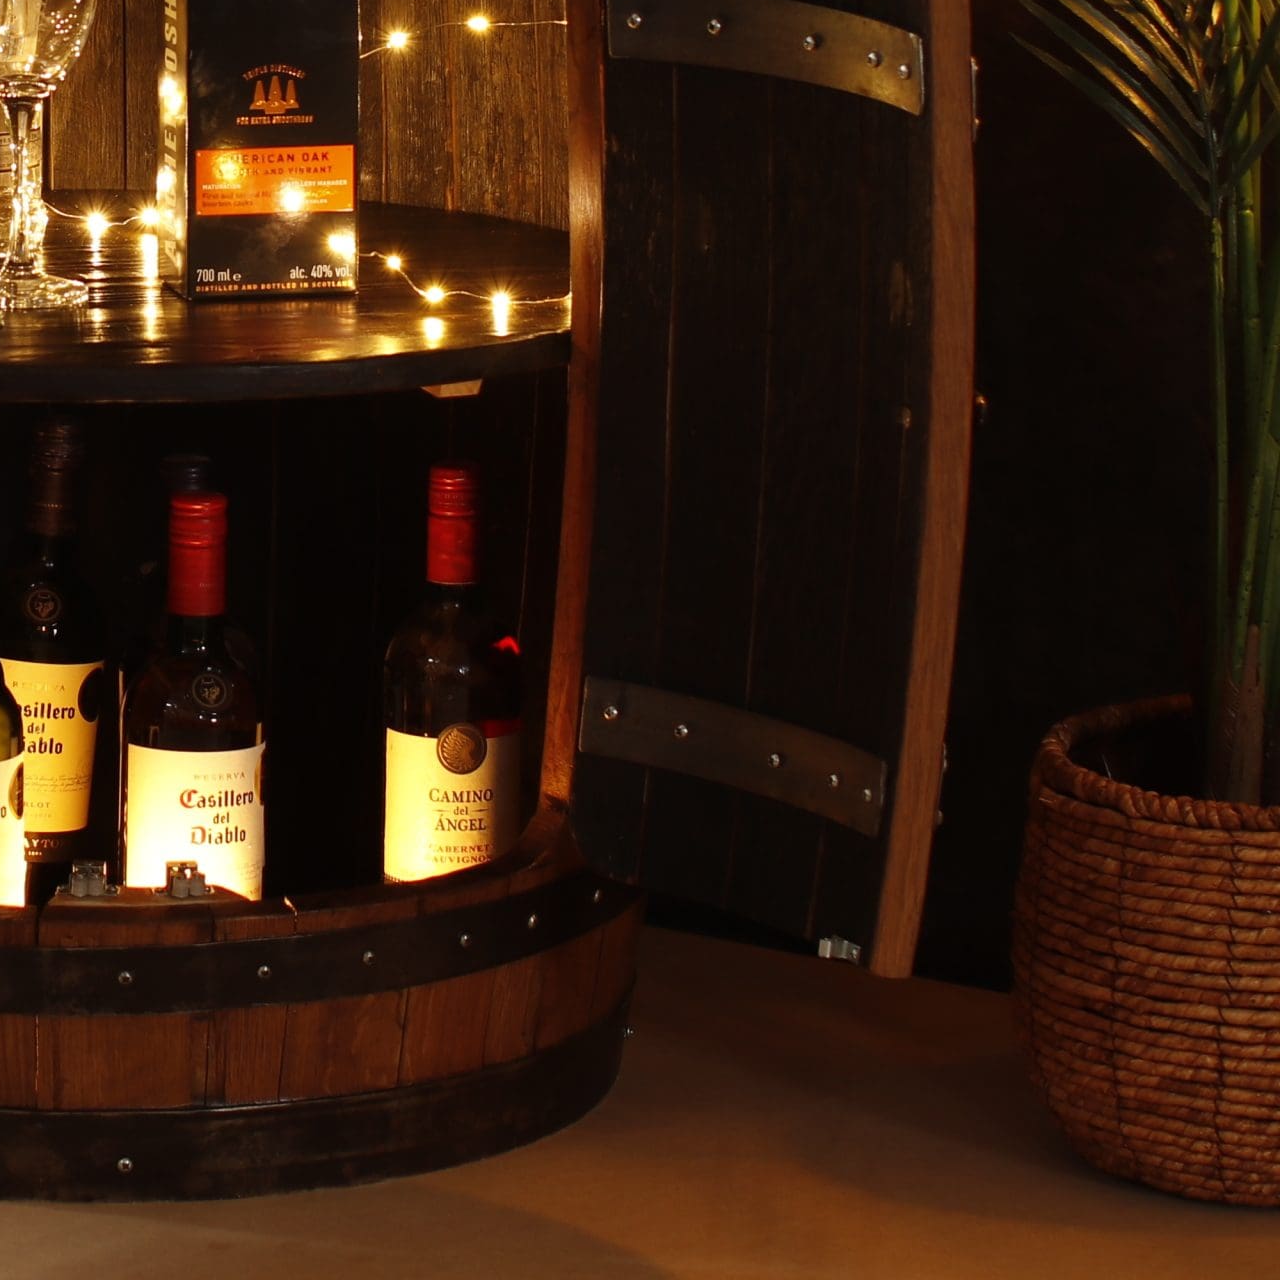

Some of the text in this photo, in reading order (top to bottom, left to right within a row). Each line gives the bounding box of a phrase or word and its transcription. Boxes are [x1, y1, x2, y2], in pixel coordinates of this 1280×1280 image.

[222, 152, 329, 165] MERICAN OAK
[219, 168, 258, 177] SOOTH
[196, 269, 215, 283] 700
[217, 268, 231, 282] ml
[289, 263, 353, 279] alc. 40% vol.
[196, 284, 238, 292] DISTILLED
[241, 283, 257, 291] AND
[260, 282, 297, 290] BOTTLED
[312, 279, 353, 288] SCOTLAND
[27, 722, 45, 735] del
[22, 736, 63, 754] iablo
[179, 788, 254, 809] Casillero
[429, 788, 494, 803] CAMINO
[453, 806, 469, 815] del
[213, 813, 230, 824] del
[434, 814, 487, 831] ÁNGEL
[190, 825, 246, 845] Diablo
[431, 854, 493, 864] AUVIGNO
